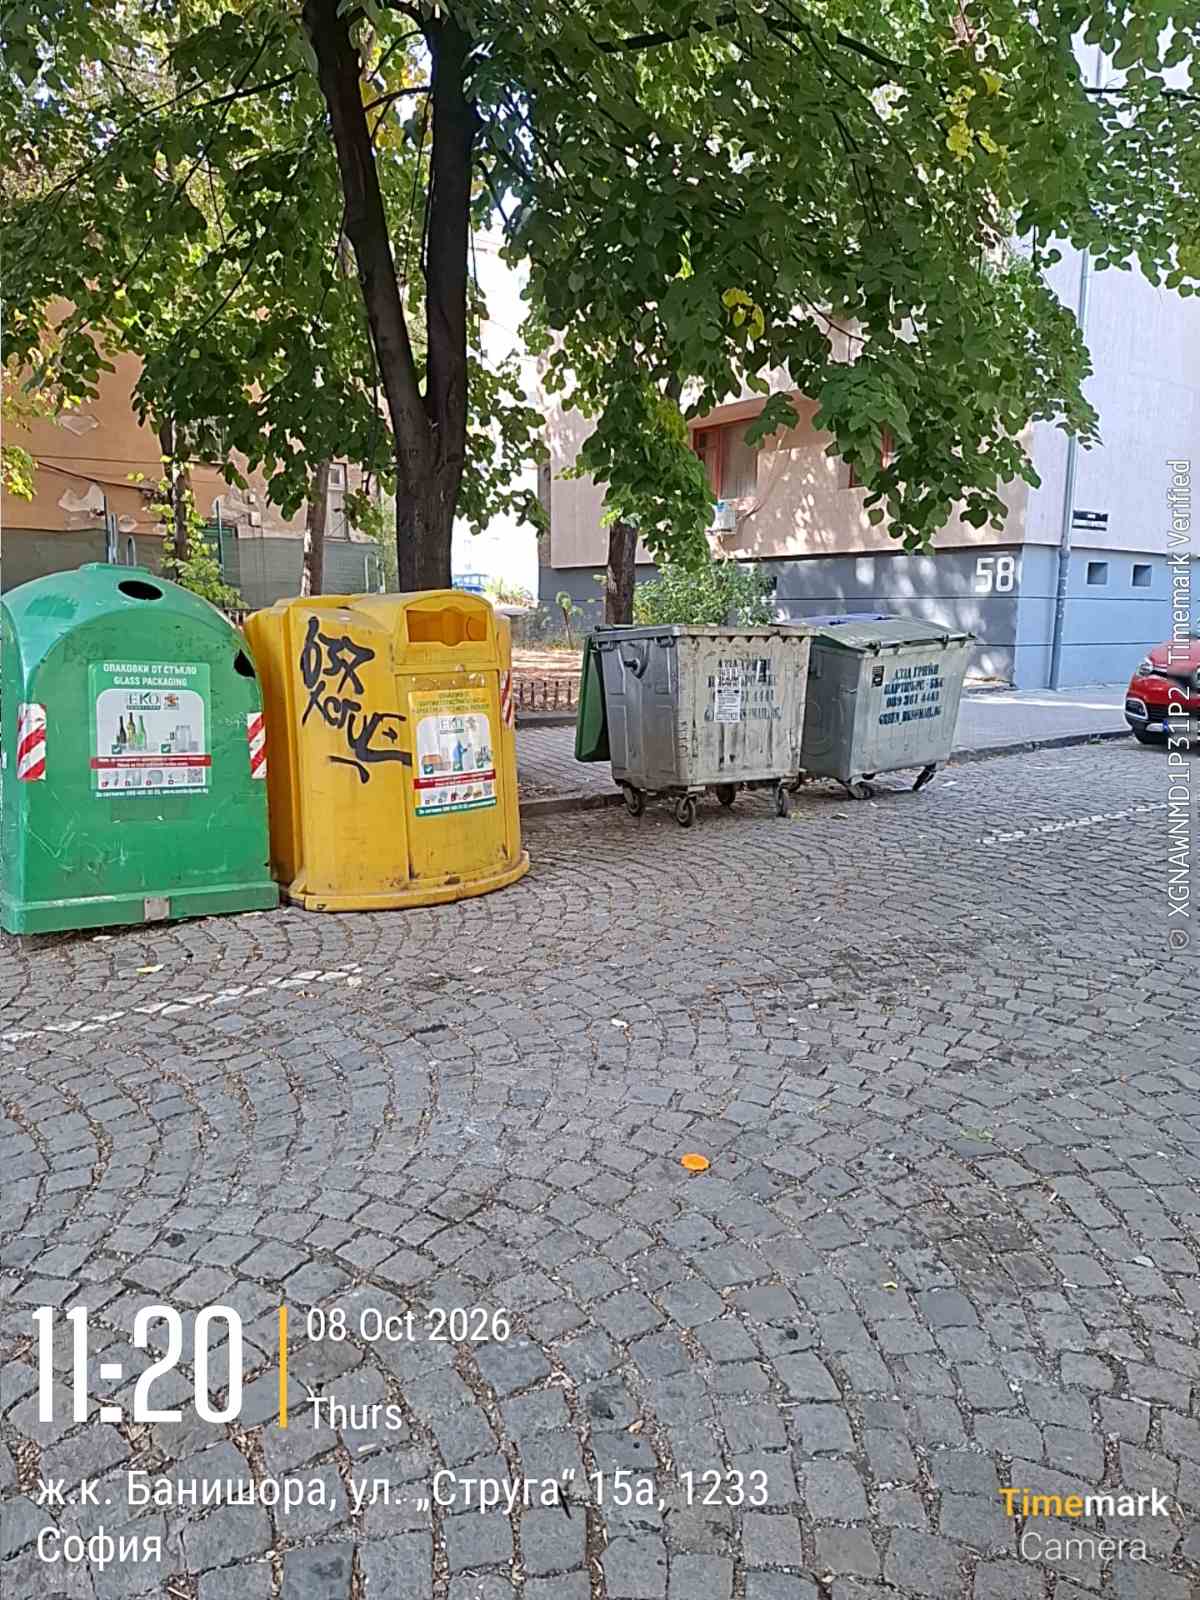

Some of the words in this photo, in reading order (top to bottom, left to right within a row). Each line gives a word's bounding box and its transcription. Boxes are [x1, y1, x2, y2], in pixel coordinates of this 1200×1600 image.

[975, 556, 1015, 593] 58
[103, 663, 149, 673] ОПАКОВКИ
[151, 664, 162, 674] ОТ
[163, 665, 197, 675] СТЪКЛО
[113, 676, 140, 686] GLASS
[142, 676, 188, 687] PACKAGING
